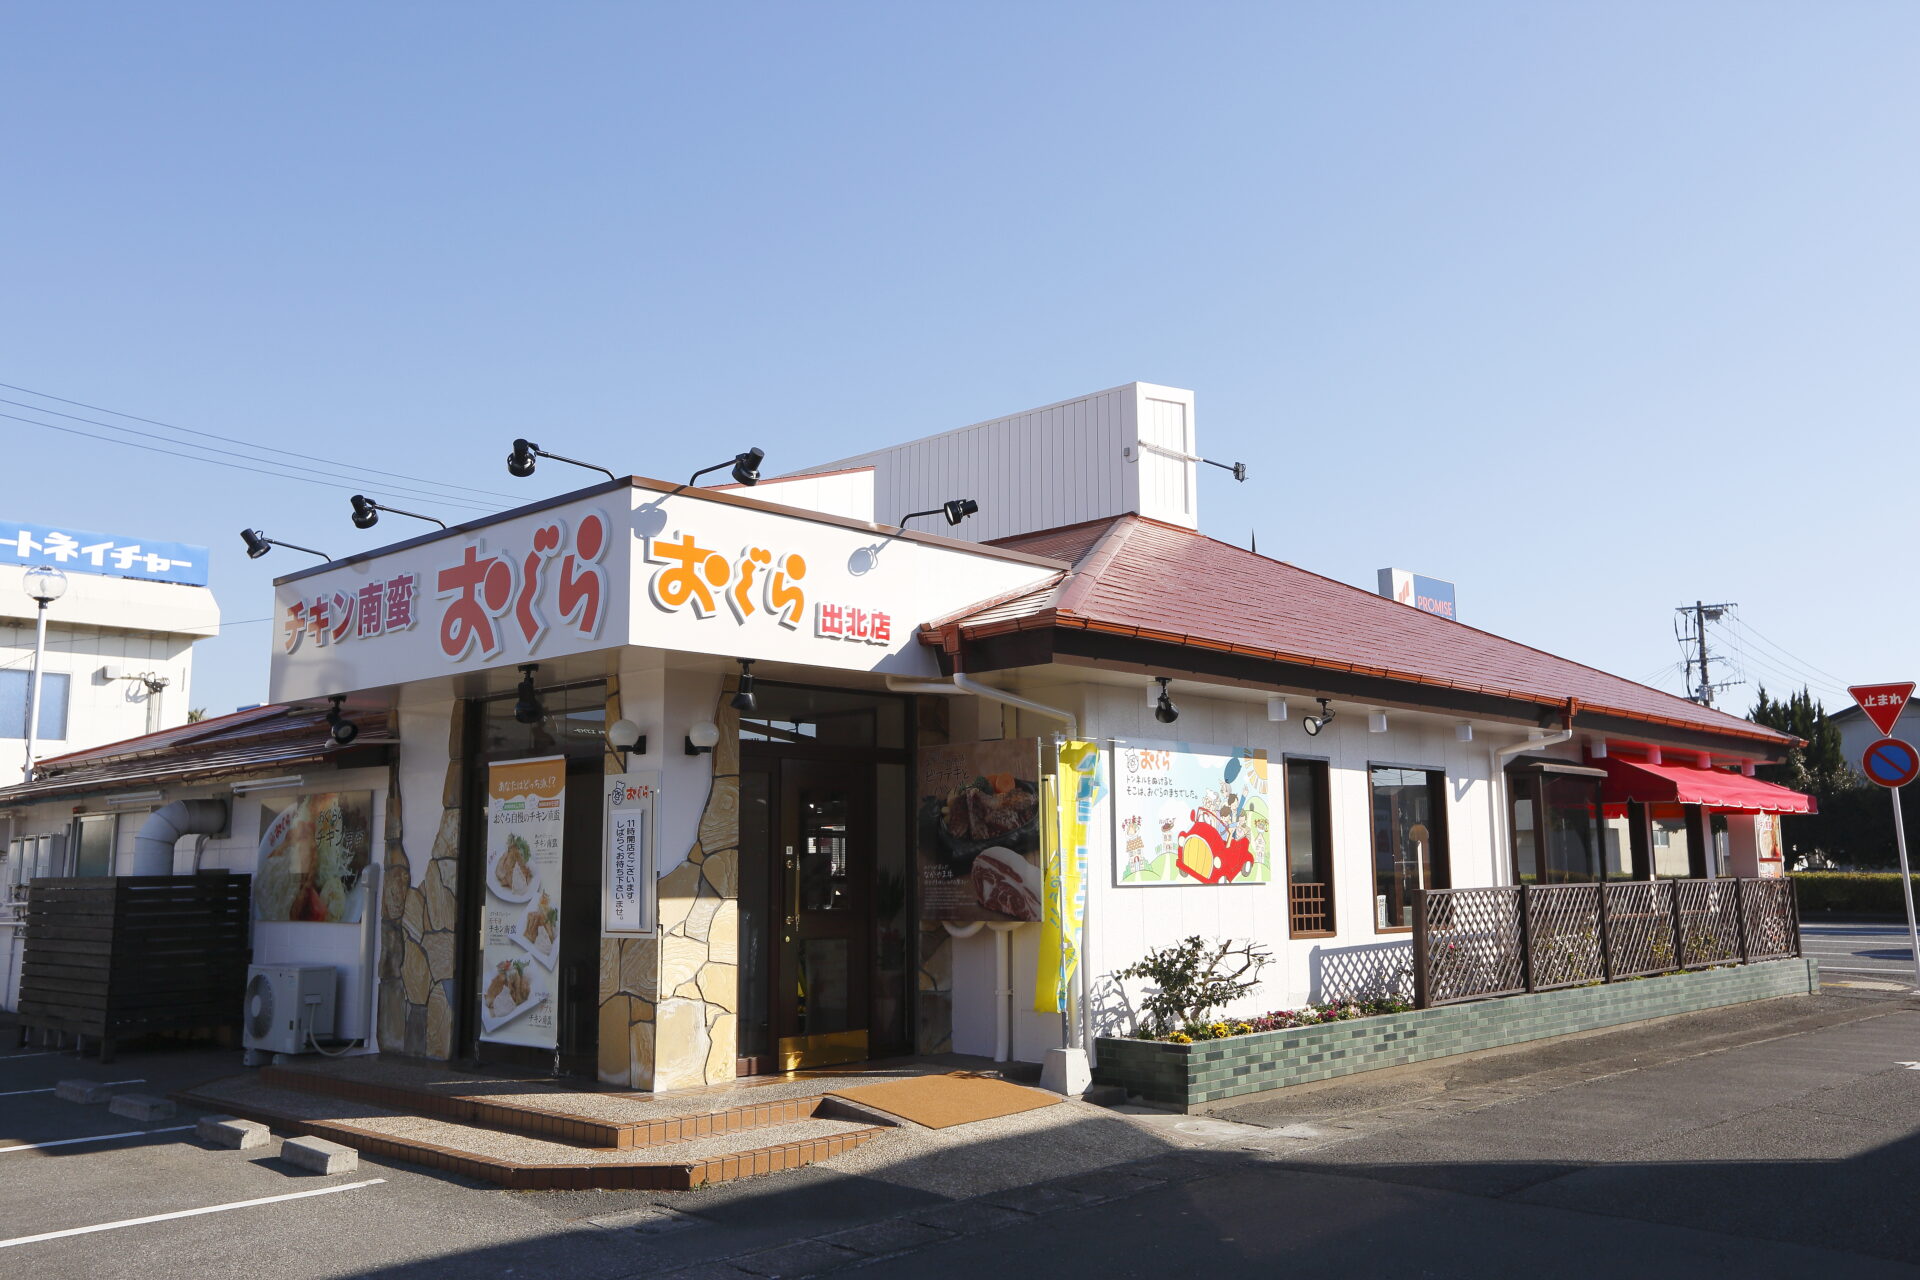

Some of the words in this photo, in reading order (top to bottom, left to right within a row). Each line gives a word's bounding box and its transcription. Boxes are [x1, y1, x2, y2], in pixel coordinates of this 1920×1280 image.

[284, 573, 415, 653] チキン南蛮
[437, 513, 605, 658] おぐら
[653, 533, 807, 624] おぐら
[820, 603, 892, 642] 出北店
[1417, 596, 1453, 616] PROMISE
[1863, 694, 1903, 708] 止まれ
[1139, 748, 1171, 771] おぐら
[1126, 775, 1173, 786] トンネルをぬけると
[626, 785, 650, 800] おぐら
[615, 820, 625, 921] しばらくお待ち下さいませ。
[626, 819, 635, 904] 11時開店でございます。
